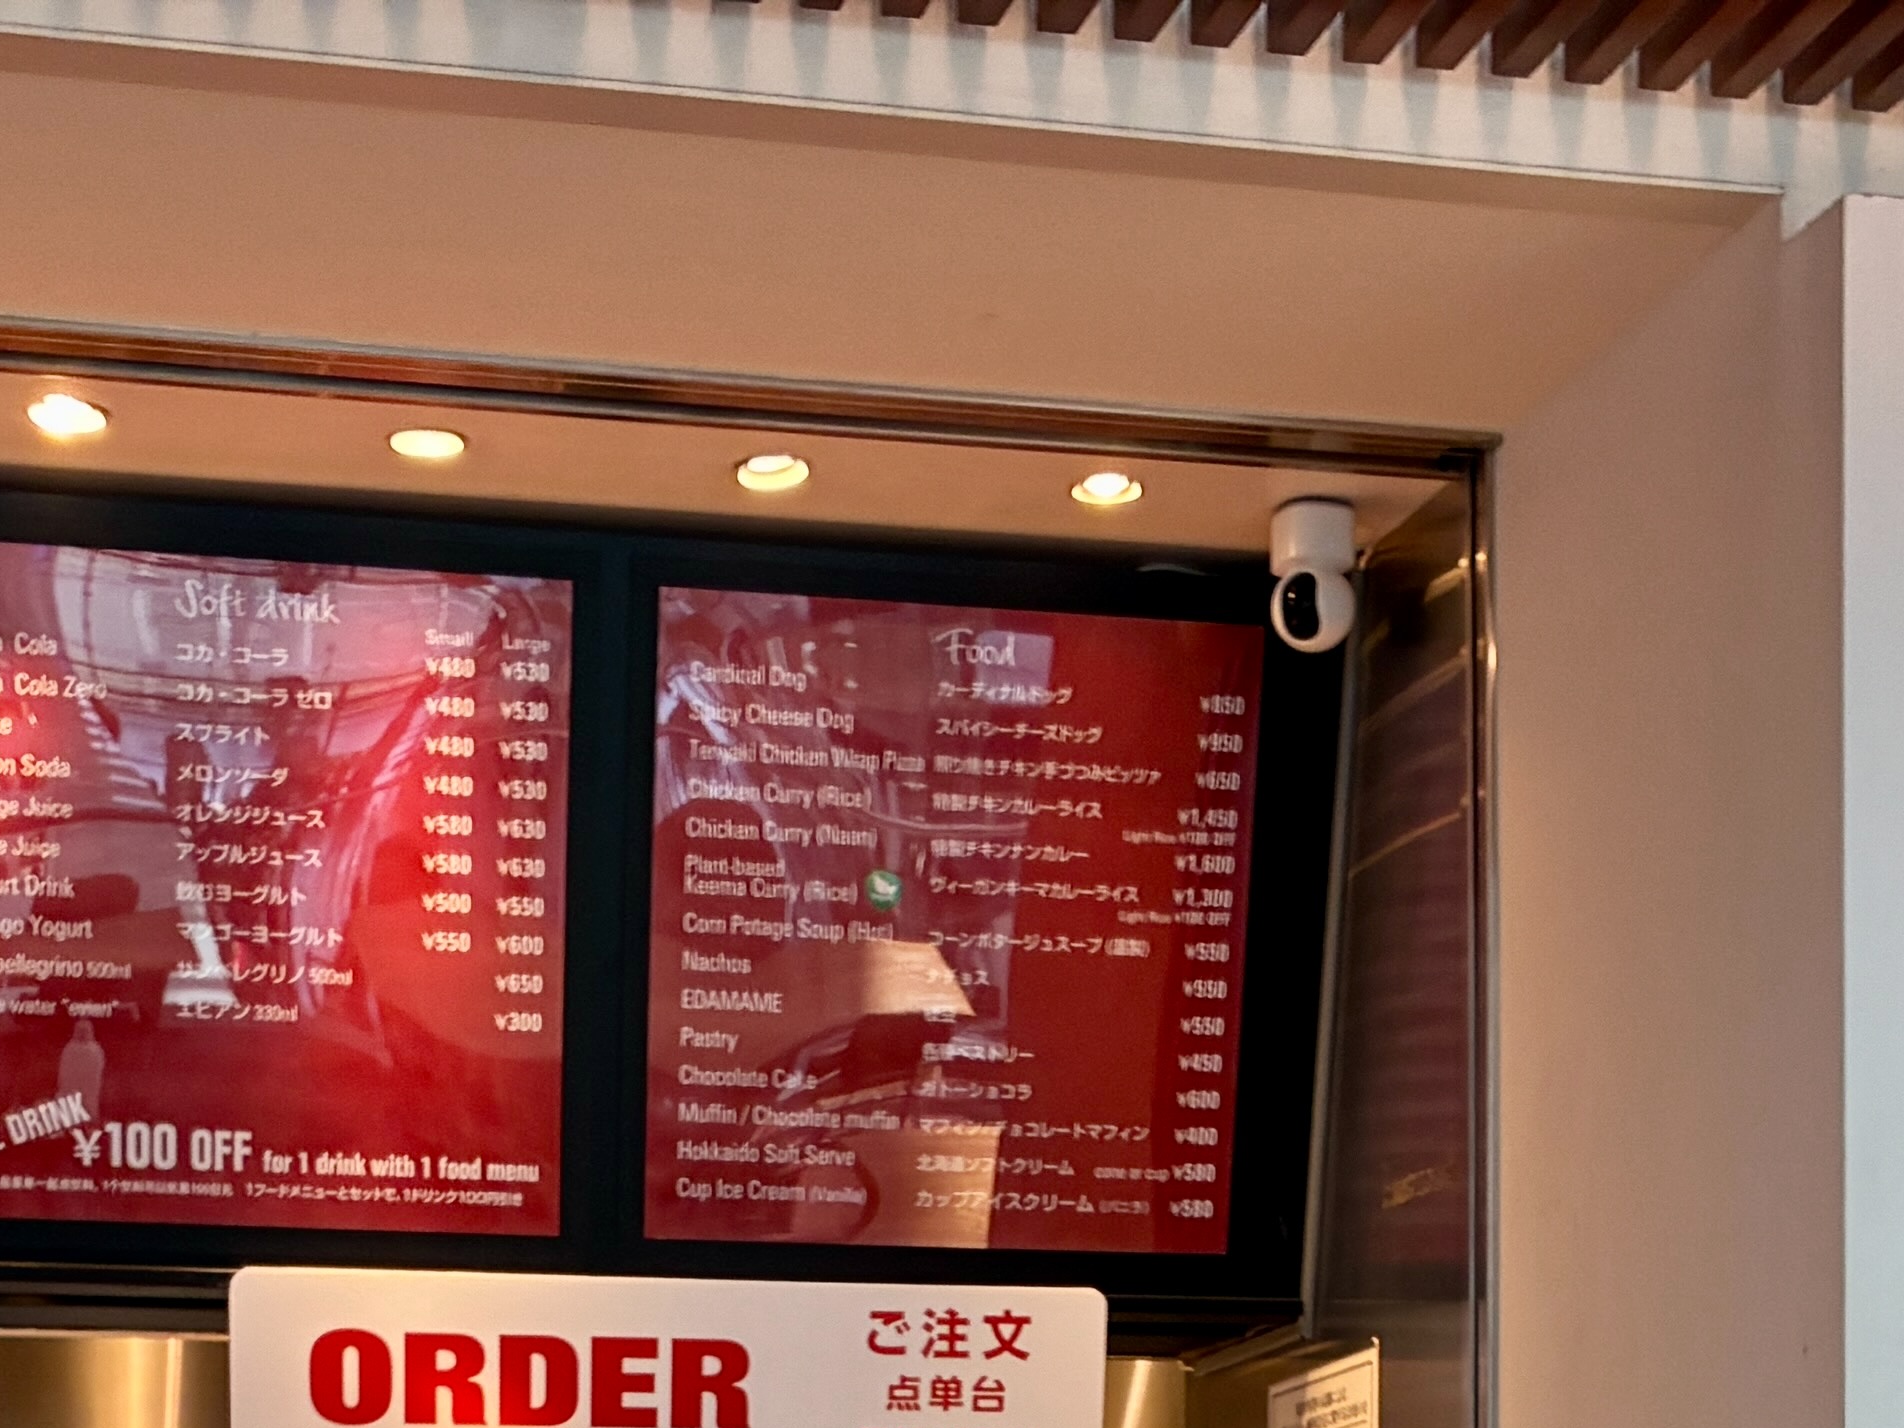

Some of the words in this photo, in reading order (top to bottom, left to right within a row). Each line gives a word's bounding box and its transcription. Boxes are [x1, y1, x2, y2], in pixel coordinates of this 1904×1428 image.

[176, 579, 245, 619] Soft
[256, 591, 339, 625] drink
[931, 628, 1016, 665] Food
[21, 754, 70, 779] Soda
[23, 795, 73, 819] Juice
[25, 875, 74, 899] Drink
[6, 1092, 90, 1145] DRINK
[74, 1121, 178, 1171] ¥100
[191, 1130, 252, 1172] OFF
[263, 1150, 292, 1173] for
[299, 1151, 308, 1174] 1
[316, 1151, 366, 1176] drink
[372, 1152, 415, 1178] with
[421, 1156, 431, 1178] 1
[439, 1156, 481, 1180] food
[487, 1162, 539, 1182] menu
[866, 1309, 1032, 1361] ご注文
[886, 1375, 1007, 1414] 点单台
